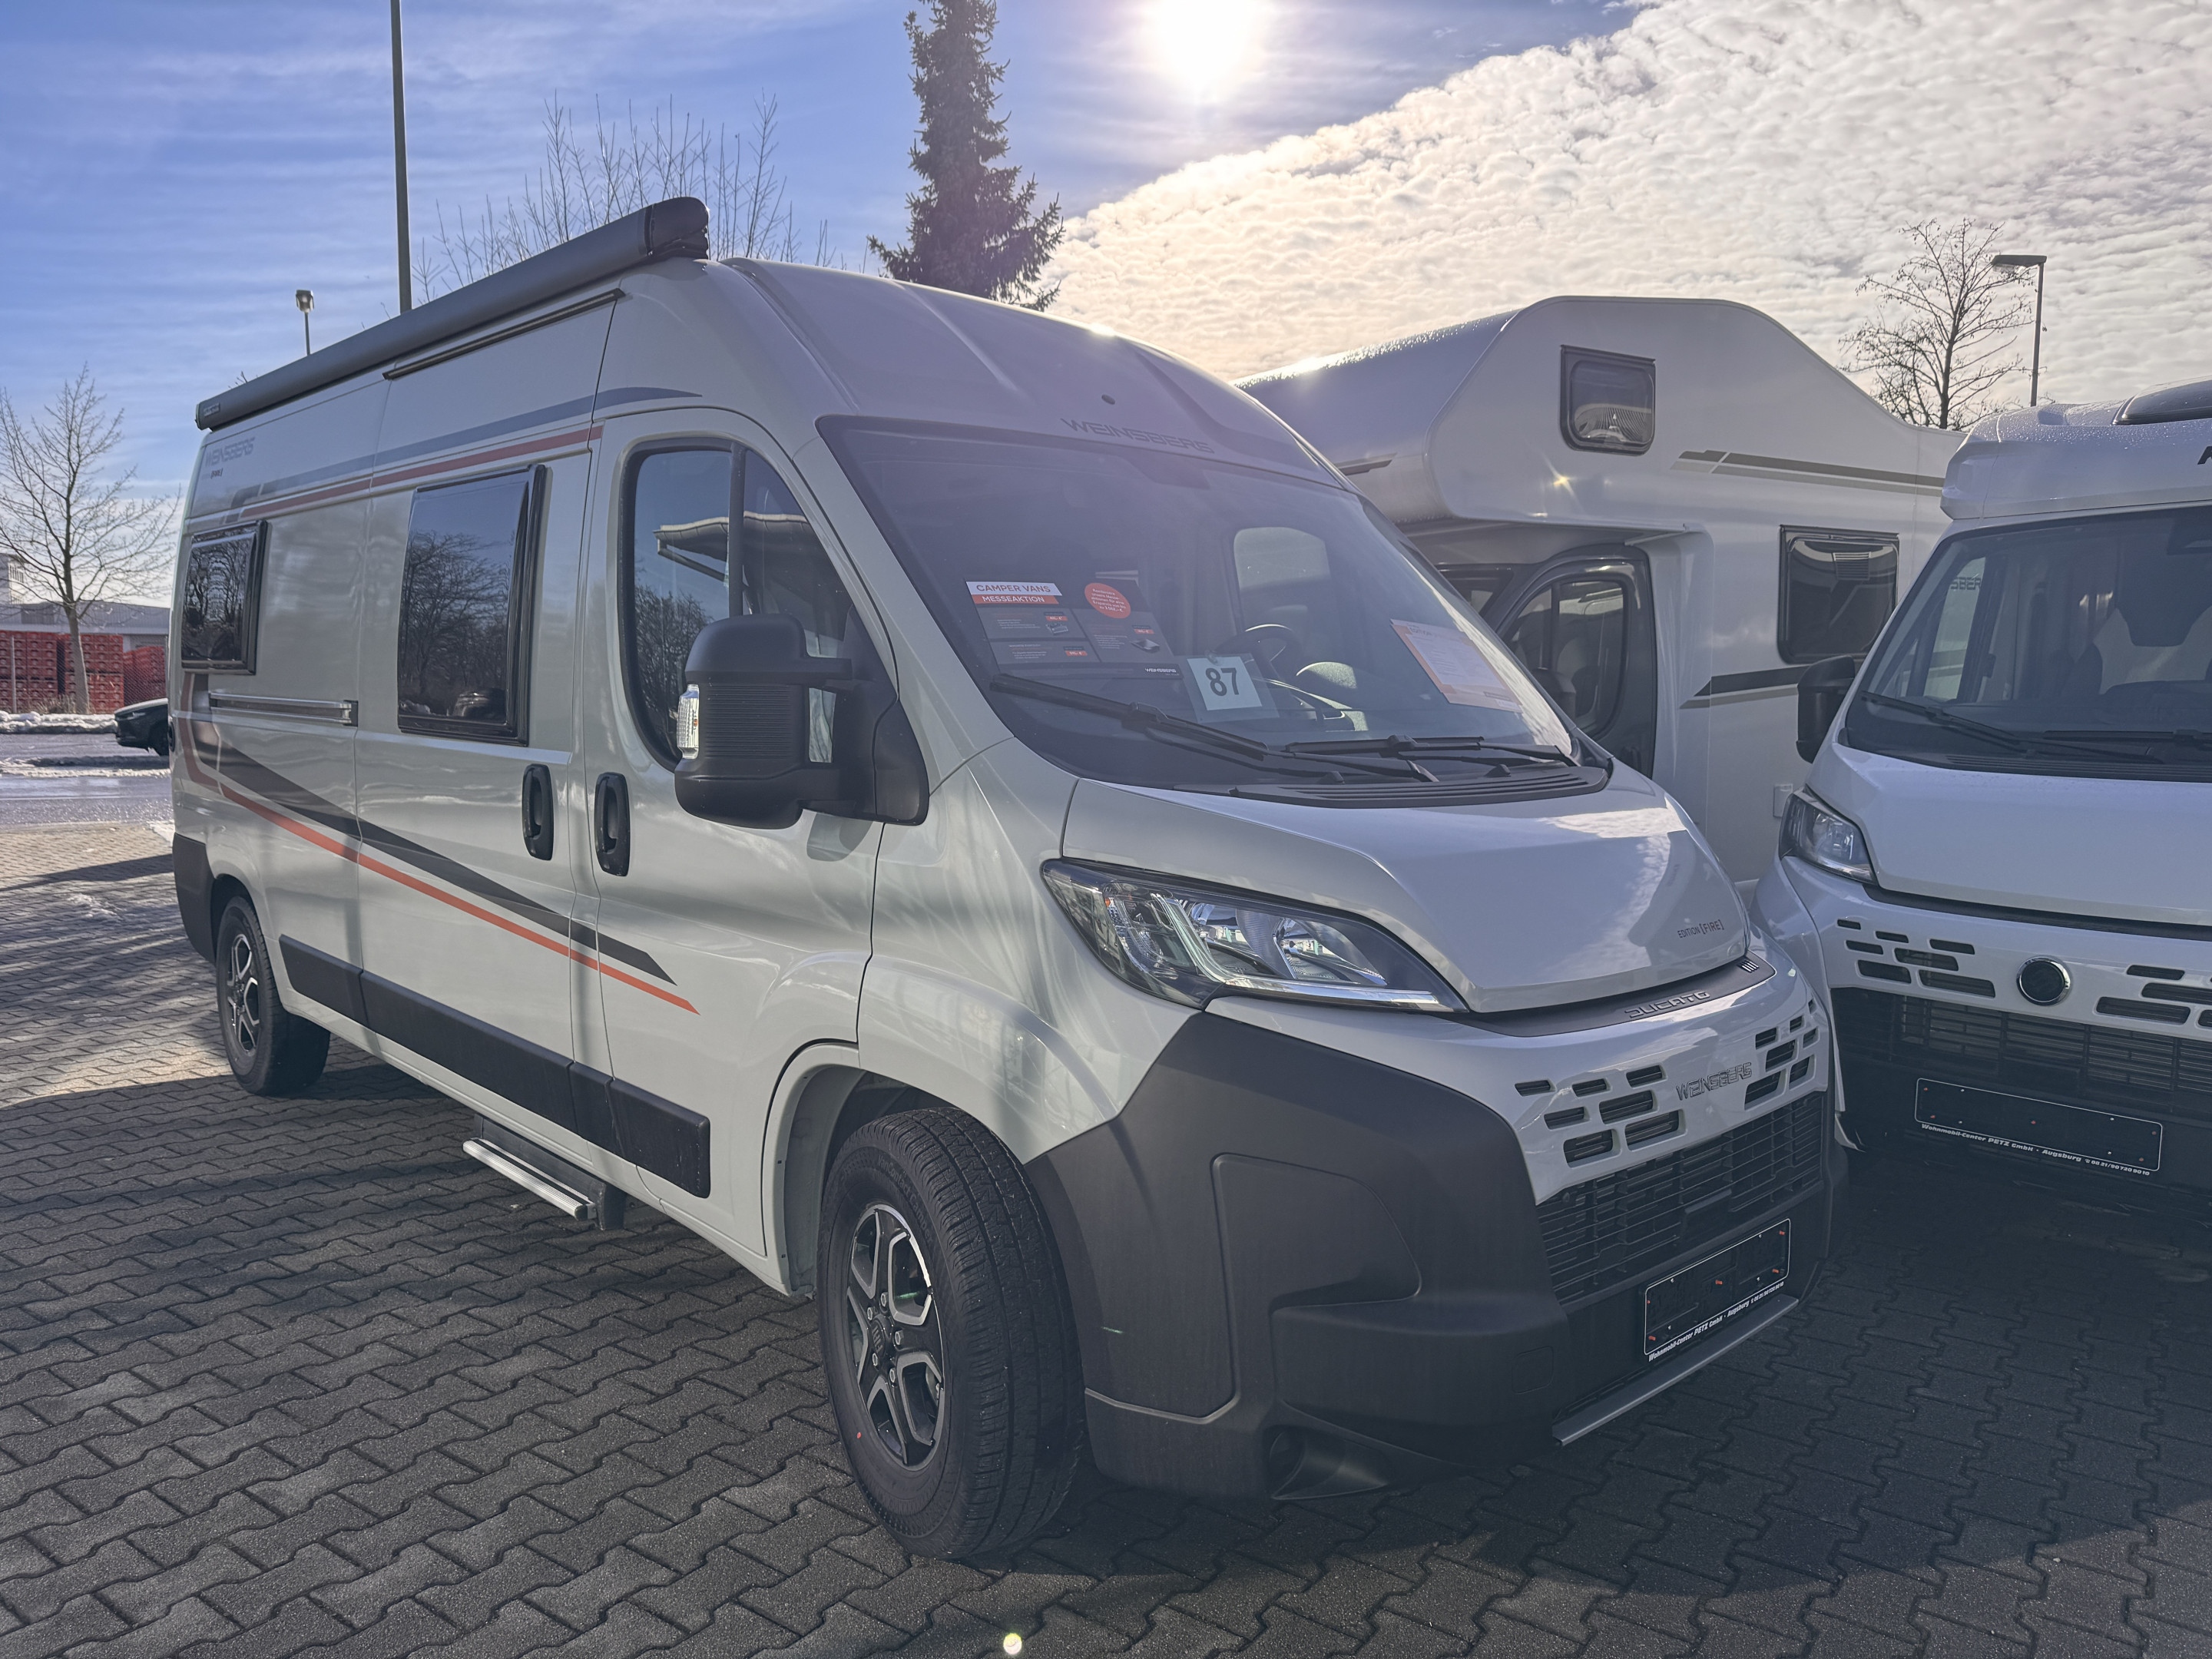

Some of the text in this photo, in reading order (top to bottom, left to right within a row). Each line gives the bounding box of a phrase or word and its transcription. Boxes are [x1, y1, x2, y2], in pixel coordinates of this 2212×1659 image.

[1060, 418, 1215, 454] WEINSBERG
[1205, 667, 1239, 697] 87
[1677, 919, 1724, 938] EDITION [FIRE]
[1624, 990, 1710, 1018] DUCATO
[1675, 1062, 1753, 1101] WEINSBERG
[1921, 1123, 1986, 1141] Wohnmobil-Center
[1988, 1137, 2009, 1147] PETZ
[2012, 1143, 2033, 1152] GmbH
[2041, 1149, 2082, 1162] Augsburg
[1694, 1322, 1708, 1336] PETZ
[1727, 1300, 1750, 1317] Augsburg
